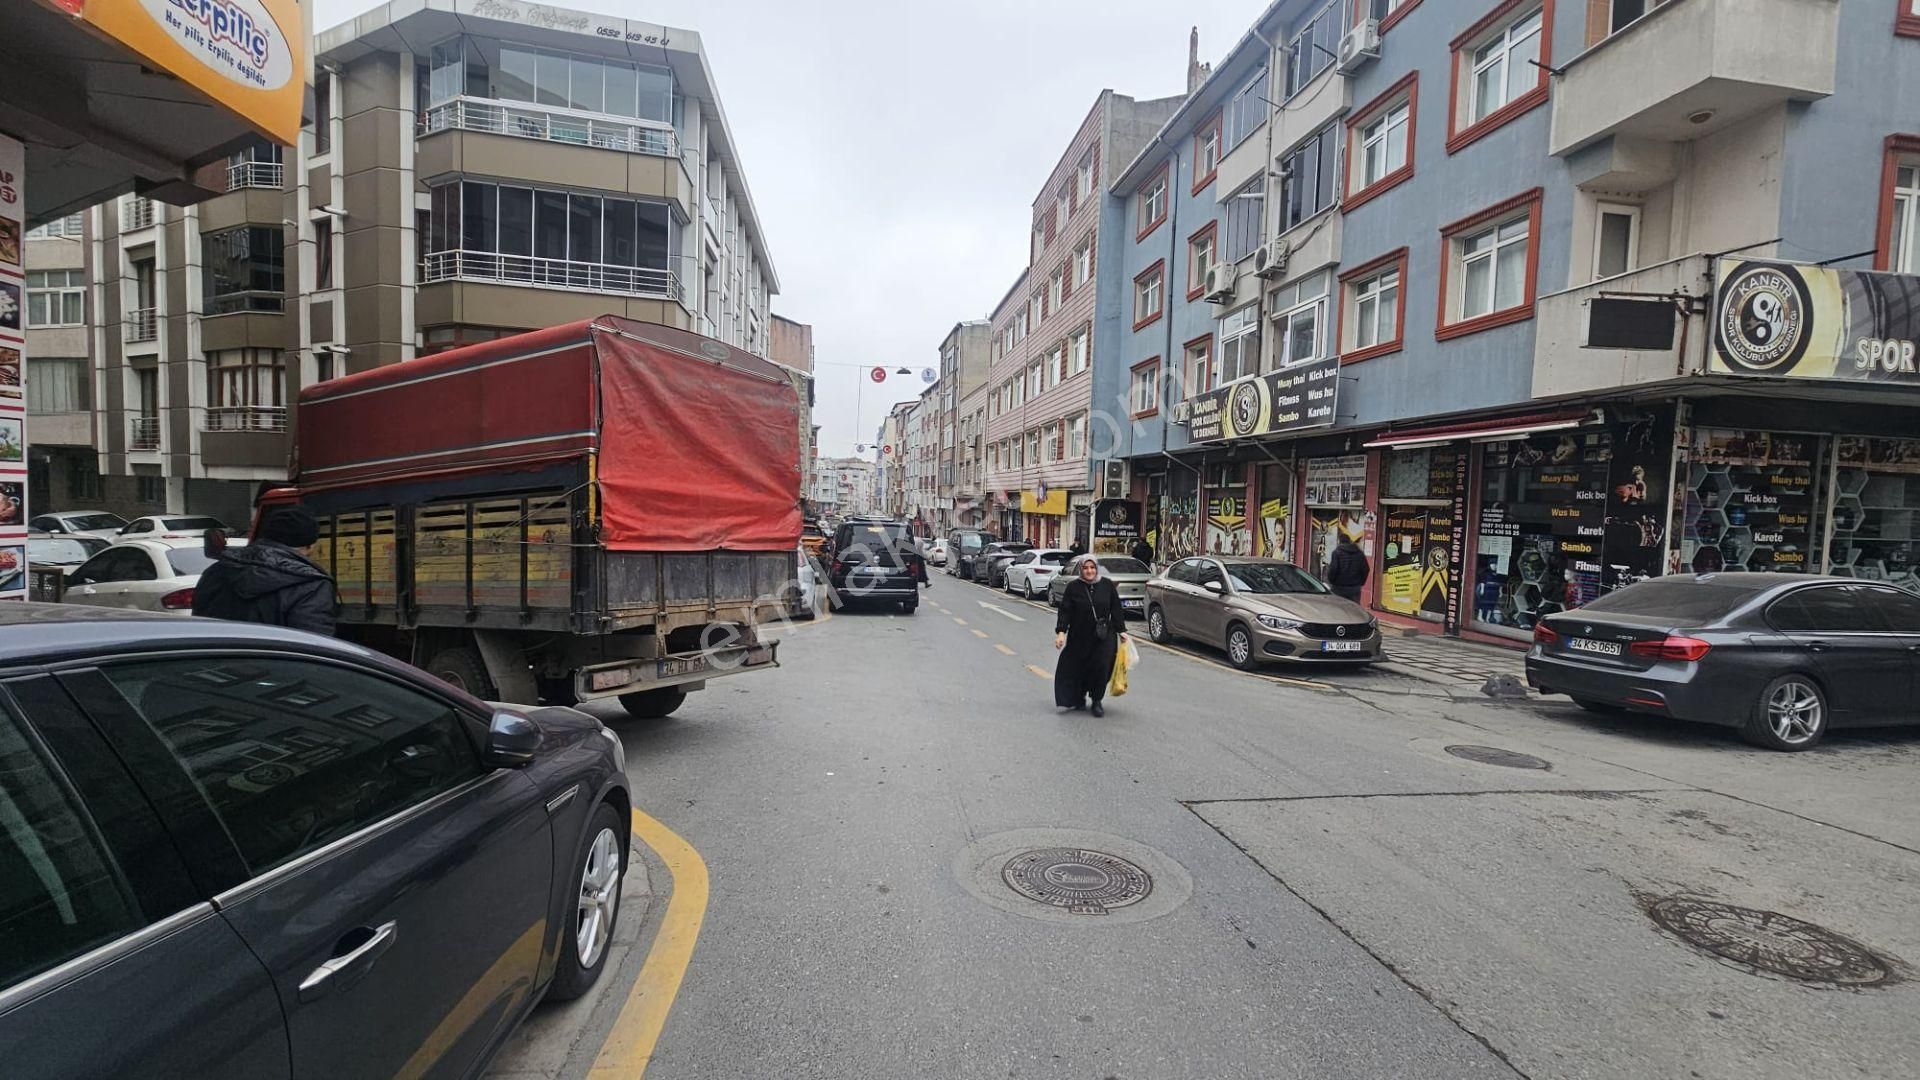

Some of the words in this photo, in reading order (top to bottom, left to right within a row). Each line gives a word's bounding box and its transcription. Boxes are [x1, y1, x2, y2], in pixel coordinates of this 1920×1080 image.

[165, 9, 181, 29] Her
[185, 25, 204, 47] piliç
[207, 40, 235, 67] Erpiliç
[236, 60, 266, 87] değildir
[1738, 274, 1793, 299] KANBİR
[1727, 307, 1736, 337] SPOR
[1766, 349, 1779, 360] VE
[1855, 336, 1916, 373] SPOR
[1308, 370, 1324, 382] Kick
[1324, 367, 1337, 378] box
[1307, 389, 1323, 401] Wus
[1324, 387, 1334, 398] hu
[1278, 411, 1300, 424] Sambo
[1541, 475, 1562, 484] Muay
[1563, 474, 1580, 482] thai
[1771, 476, 1793, 486] Muay
[1795, 476, 1810, 485] thai
[1576, 491, 1594, 500] Kick
[1744, 494, 1762, 503] Kick
[1763, 495, 1778, 504] box
[1551, 508, 1568, 517] Wus
[1569, 508, 1580, 517] hu
[1778, 514, 1796, 524] Wus
[1797, 515, 1808, 524] hu
[1429, 532, 1451, 541] Sambo
[1754, 532, 1784, 542] Karete
[1561, 542, 1592, 552] Sambo
[1773, 552, 1804, 562] Sambo
[1571, 638, 1583, 649] 34
[1584, 641, 1597, 651] KS
[1599, 642, 1621, 655] 0651
[664, 663, 675, 676] 34
